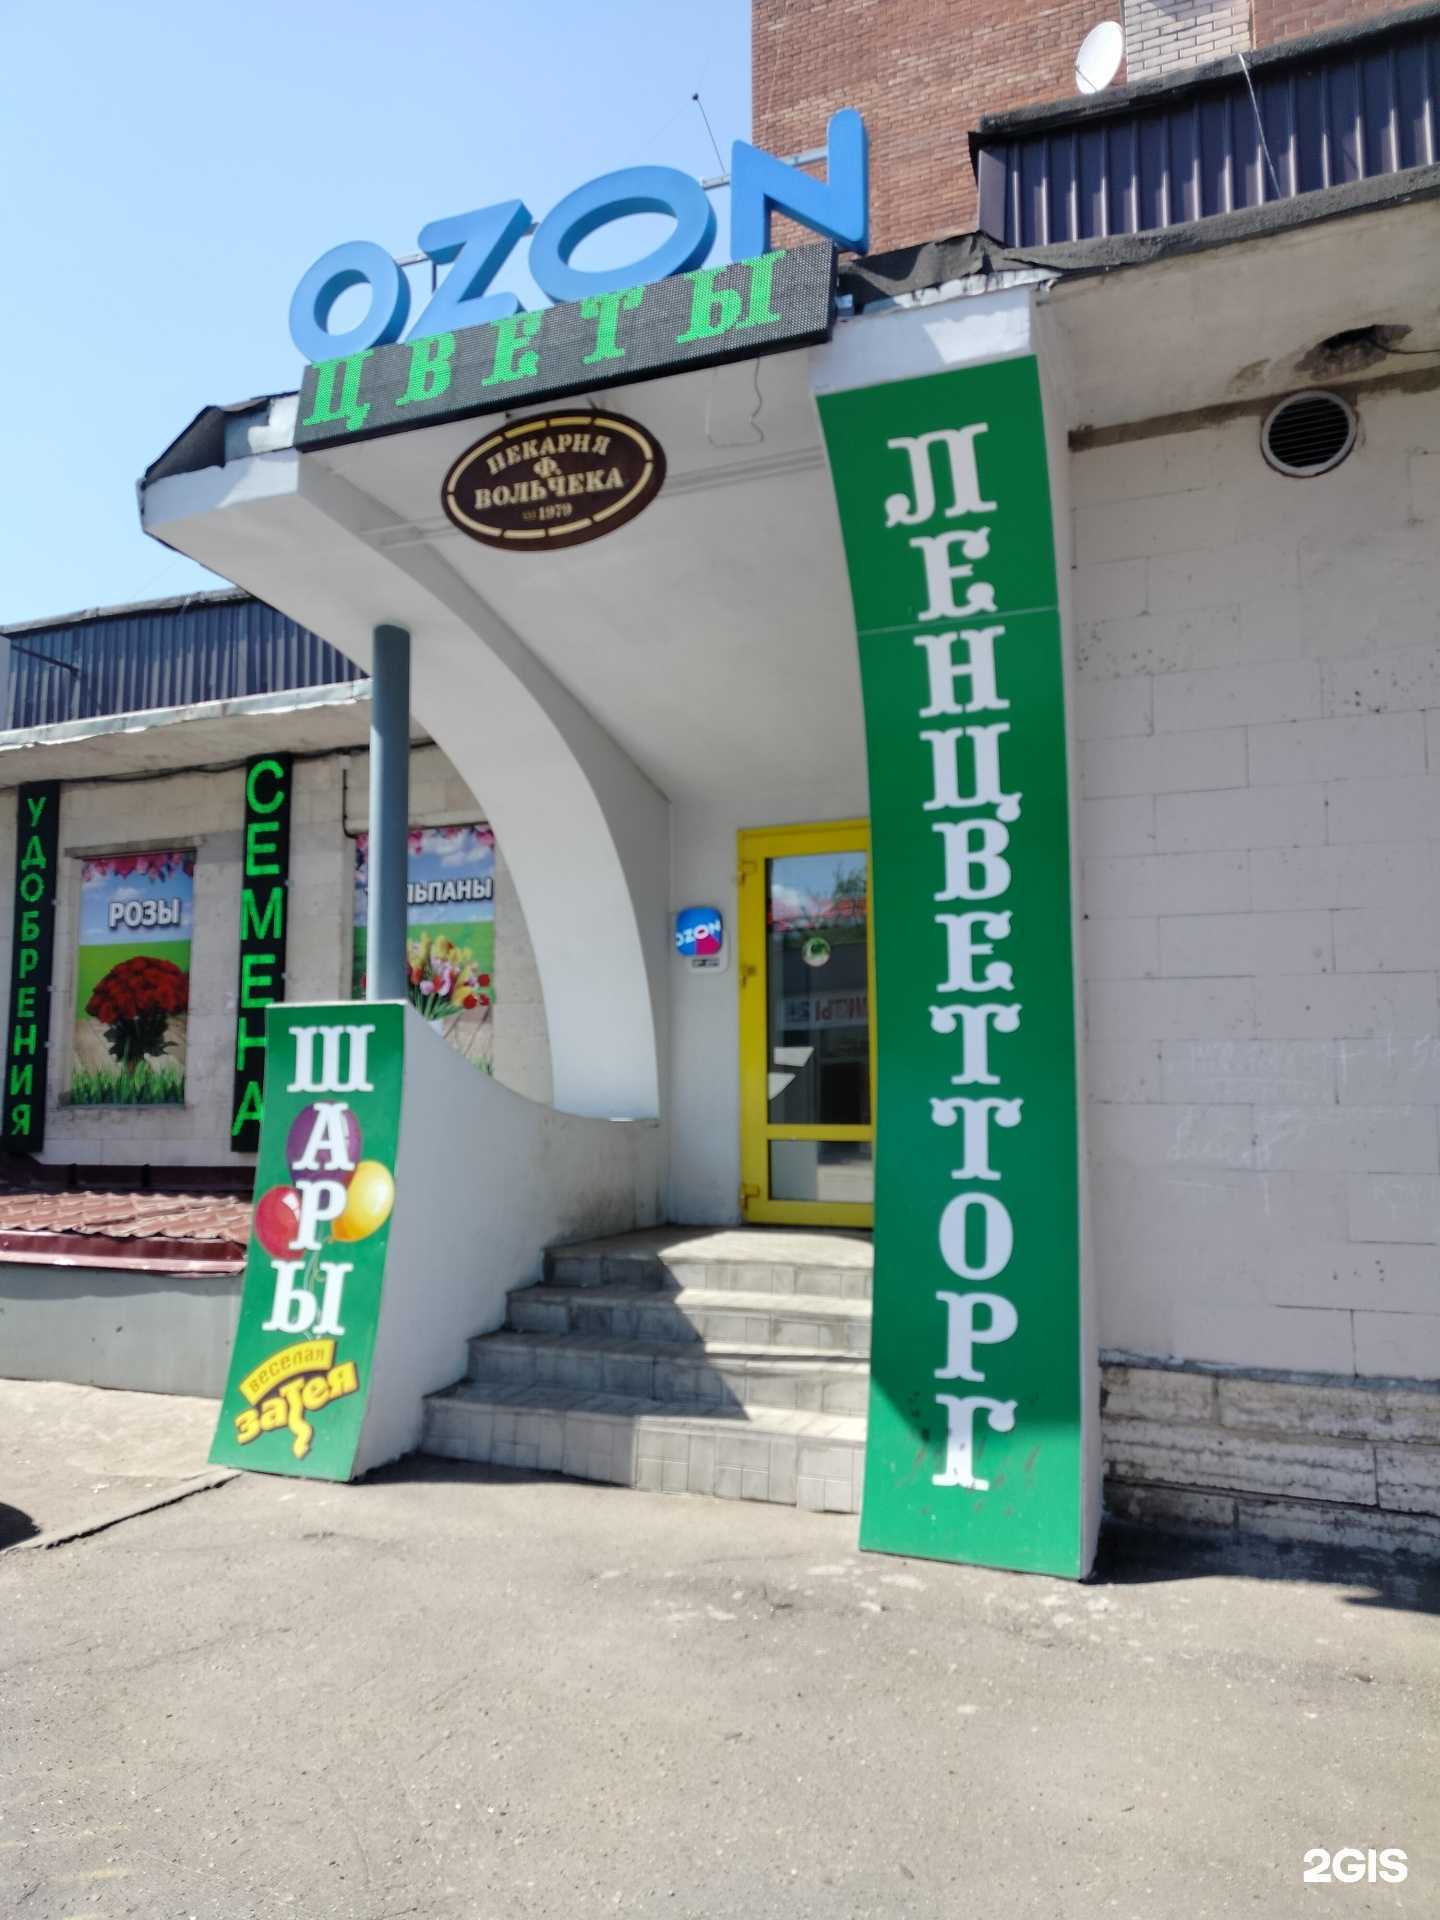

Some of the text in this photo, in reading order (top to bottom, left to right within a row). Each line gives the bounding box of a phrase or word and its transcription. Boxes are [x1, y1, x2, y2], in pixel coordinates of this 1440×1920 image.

[289, 106, 869, 365] OZON
[303, 249, 787, 431] ЦВЕТЫ
[474, 466, 625, 511] ВОЛЬЧЕКА
[486, 433, 611, 476] ПЕКАРНЯ
[533, 456, 562, 478] Ф.
[10, 796, 47, 1136] УДОБРЕНИЯ
[109, 898, 181, 929] РОЗЫ
[231, 759, 285, 1137] СЕМЕНА
[407, 878, 493, 904] ЬПАНЫ
[885, 422, 1023, 1491] ЛЕНЦВЕТТОРГ
[262, 1024, 375, 1336] ШАРЫ
